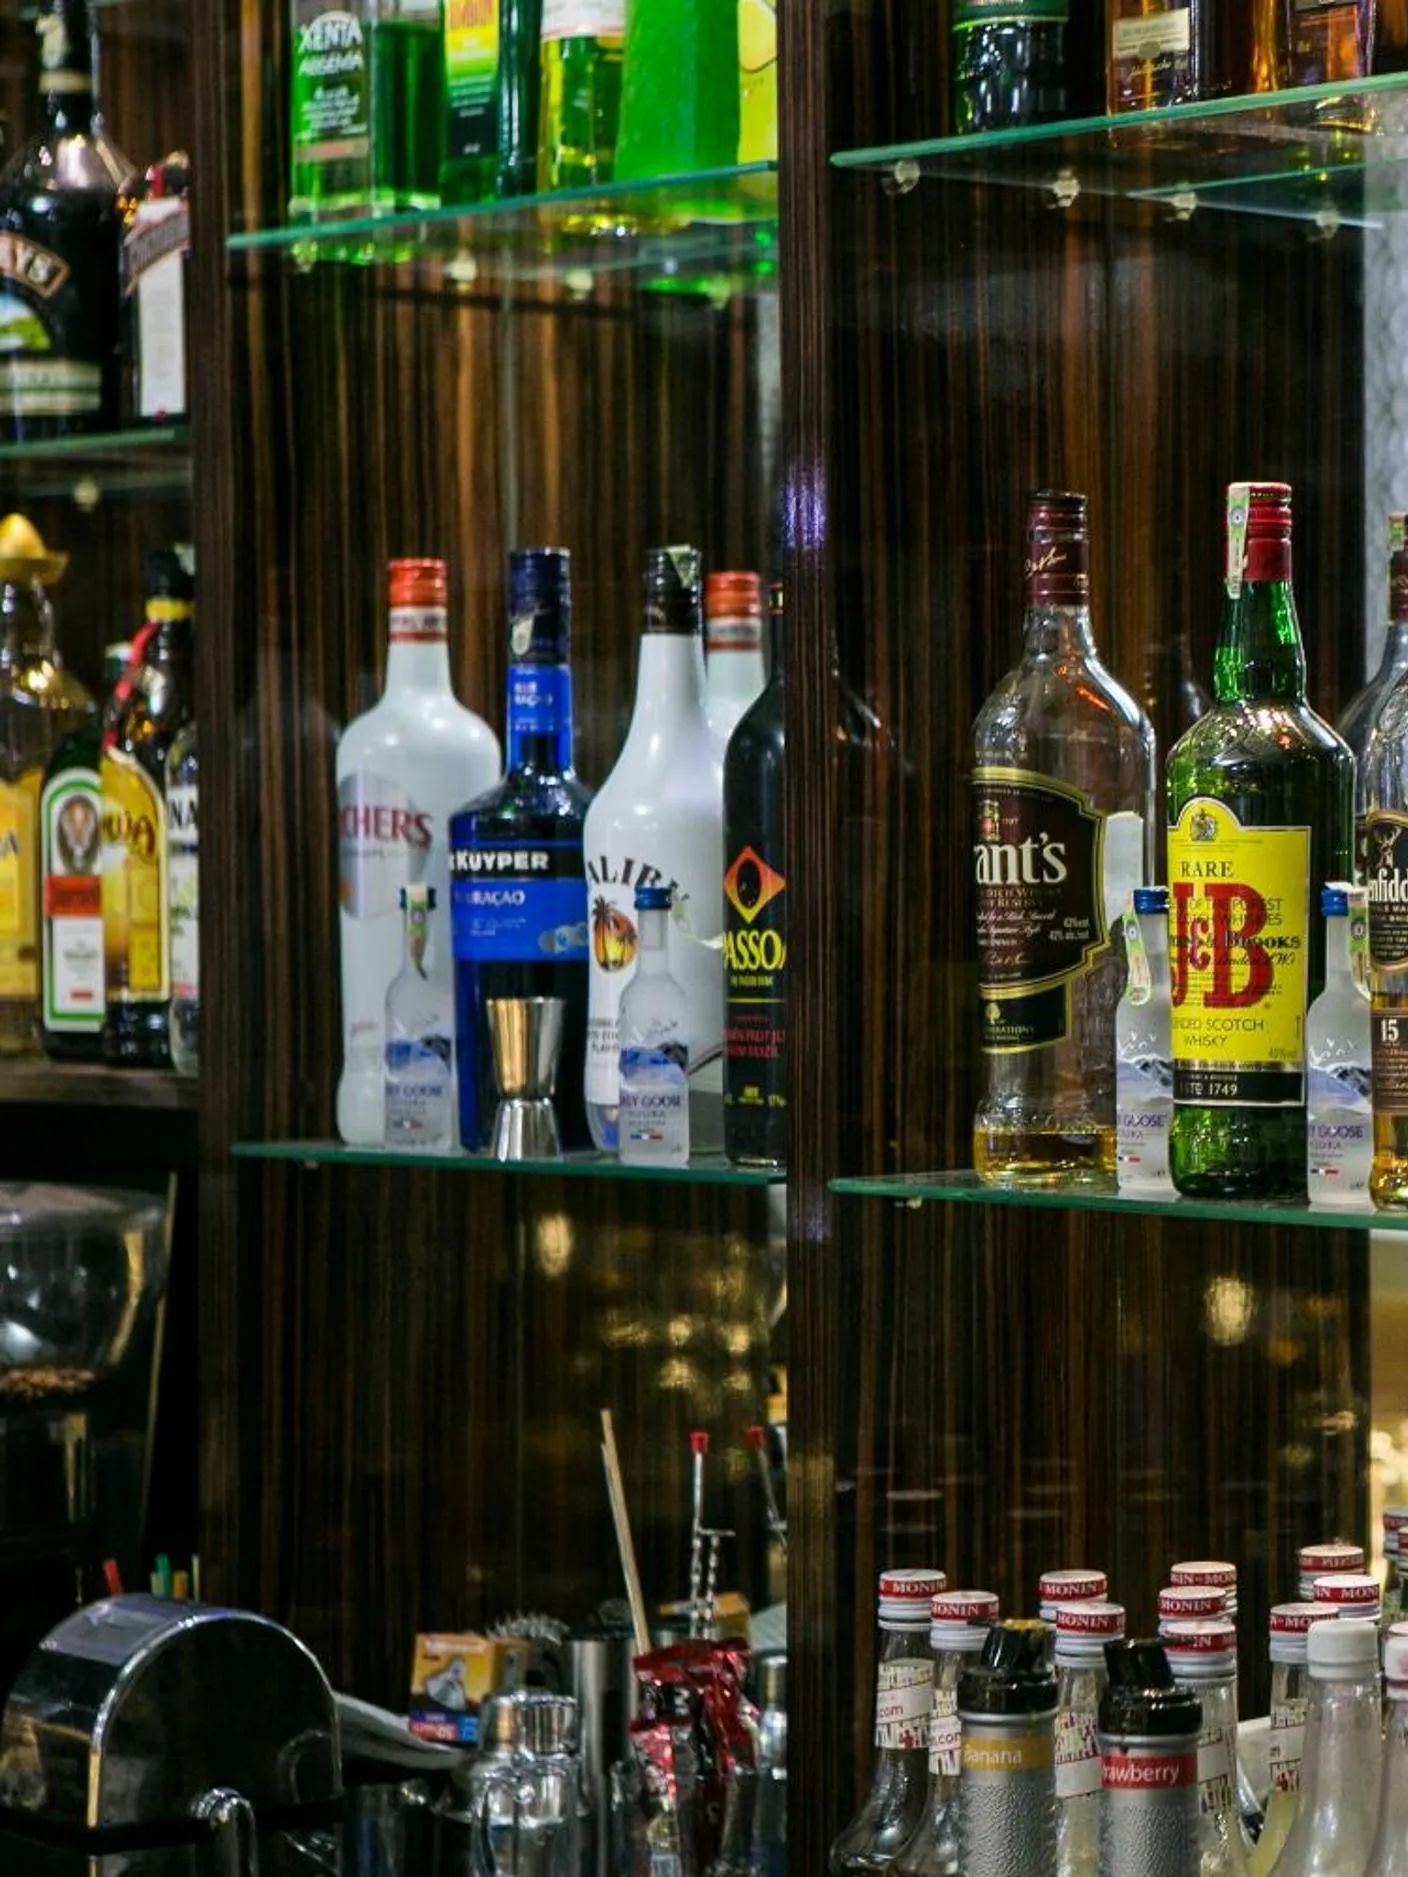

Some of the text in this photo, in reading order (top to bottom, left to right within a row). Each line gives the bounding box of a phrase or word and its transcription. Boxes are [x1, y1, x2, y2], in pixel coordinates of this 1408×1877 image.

[457, 850, 549, 871] KUYPER
[1181, 861, 1234, 877] RARE
[1206, 1017, 1265, 1031] SCOTCH
[1381, 1018, 1400, 1042] 15
[1185, 1035, 1227, 1047] WHISKY
[1208, 1082, 1238, 1096] 1749
[893, 1581, 941, 1595] MONIN
[1047, 1580, 1097, 1596] MONIN
[1160, 1599, 1212, 1612] MONIN
